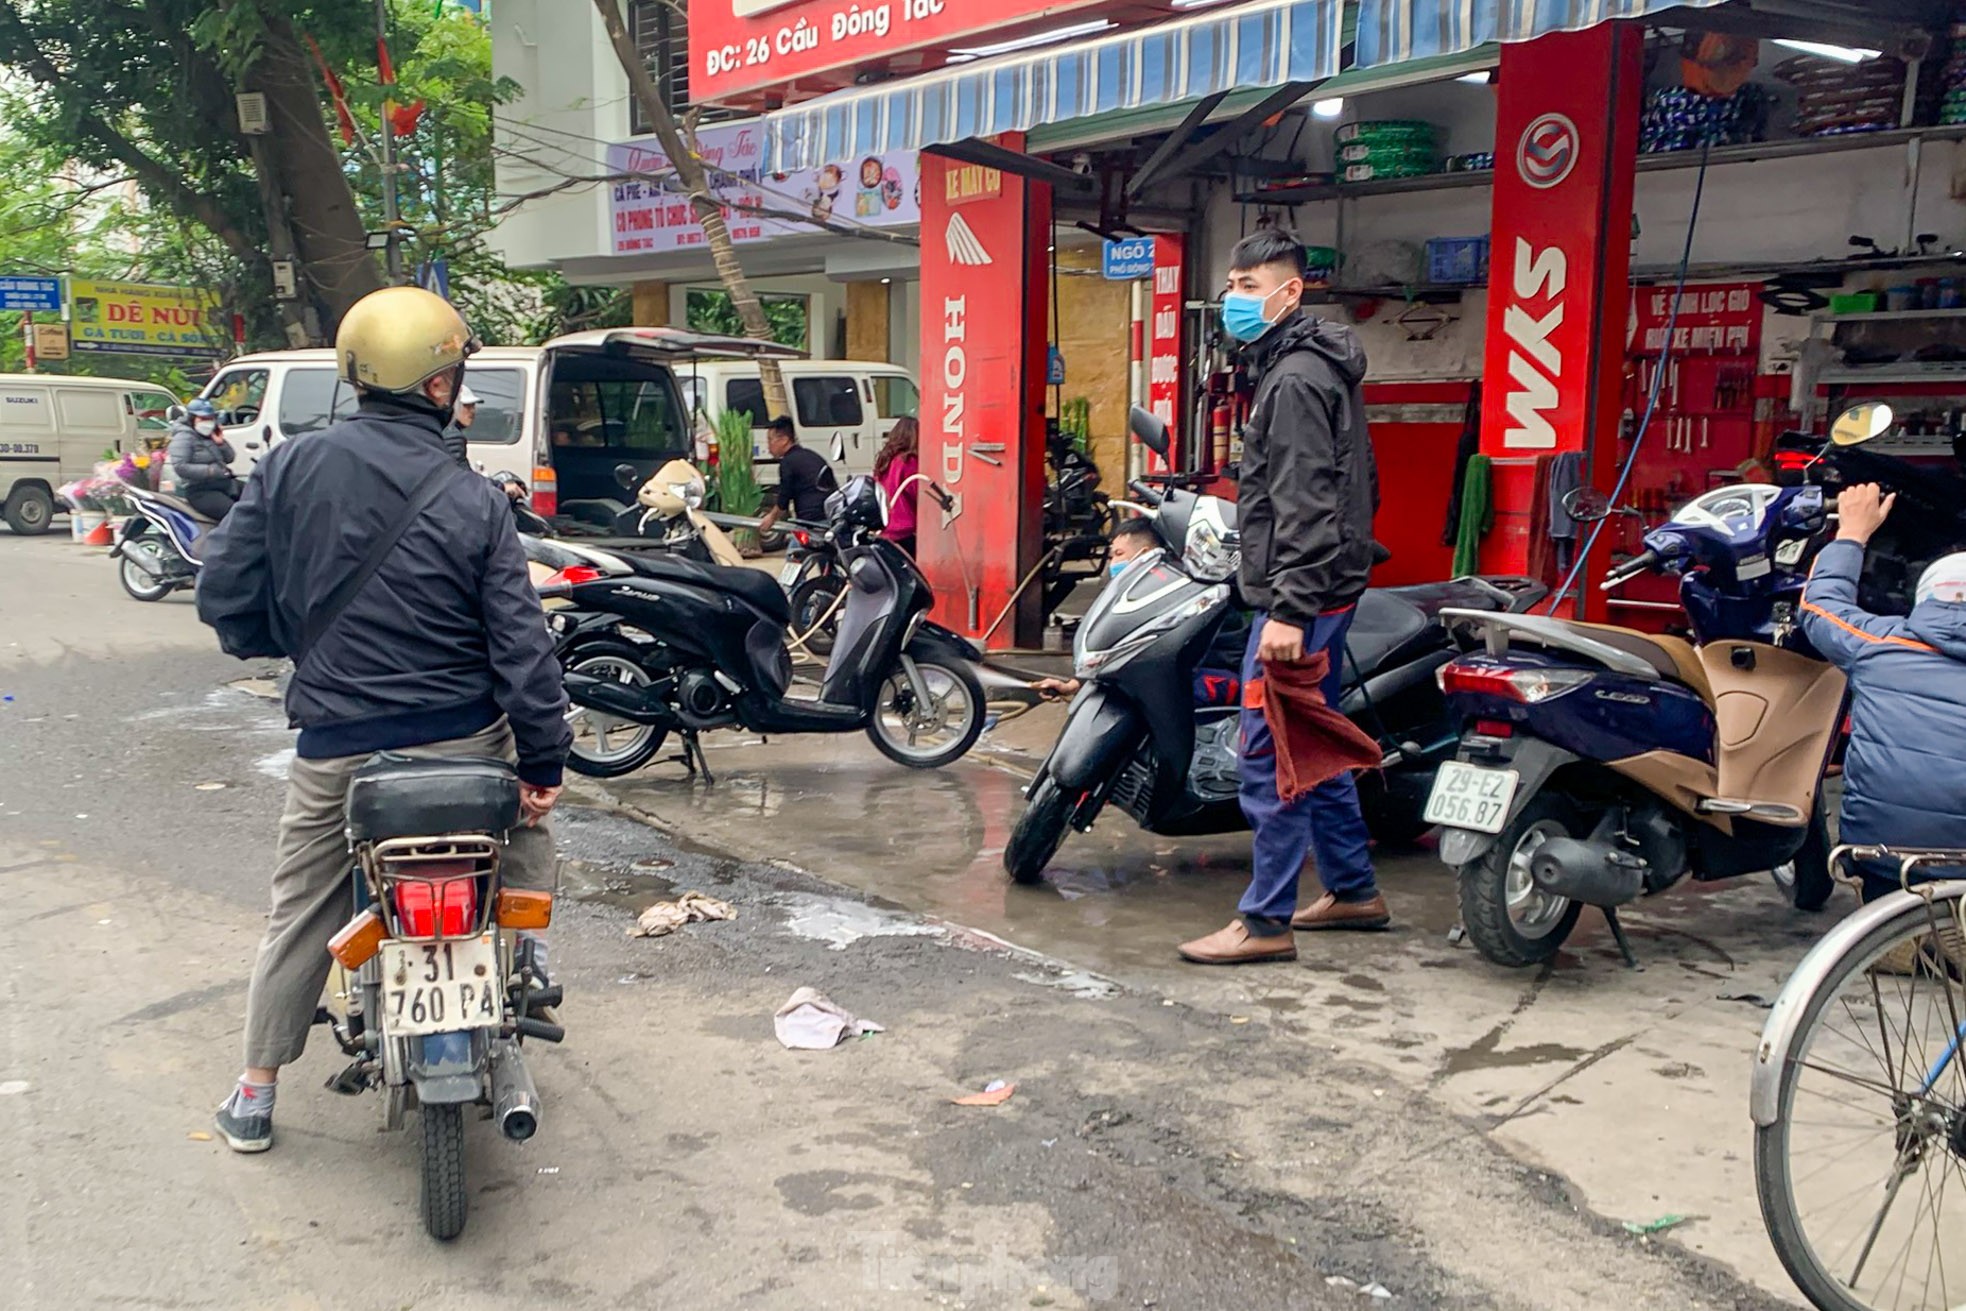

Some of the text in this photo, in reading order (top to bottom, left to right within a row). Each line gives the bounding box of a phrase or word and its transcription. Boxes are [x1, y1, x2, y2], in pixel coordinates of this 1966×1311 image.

[706, 43, 742, 77] ĐC:
[745, 35, 771, 67] 26
[775, 17, 819, 56] Cầu
[831, 7, 890, 41] Đông
[1110, 242, 1145, 261] NGÕ
[1155, 265, 1180, 295] THAY
[107, 299, 144, 323] DÊ
[1503, 236, 1567, 449] SYM
[6, 396, 38, 404] SUZUKI
[1445, 768, 1505, 799] 29-E2
[1431, 794, 1503, 827] 056.87
[421, 942, 454, 983] 31
[389, 986, 445, 1024] 760
